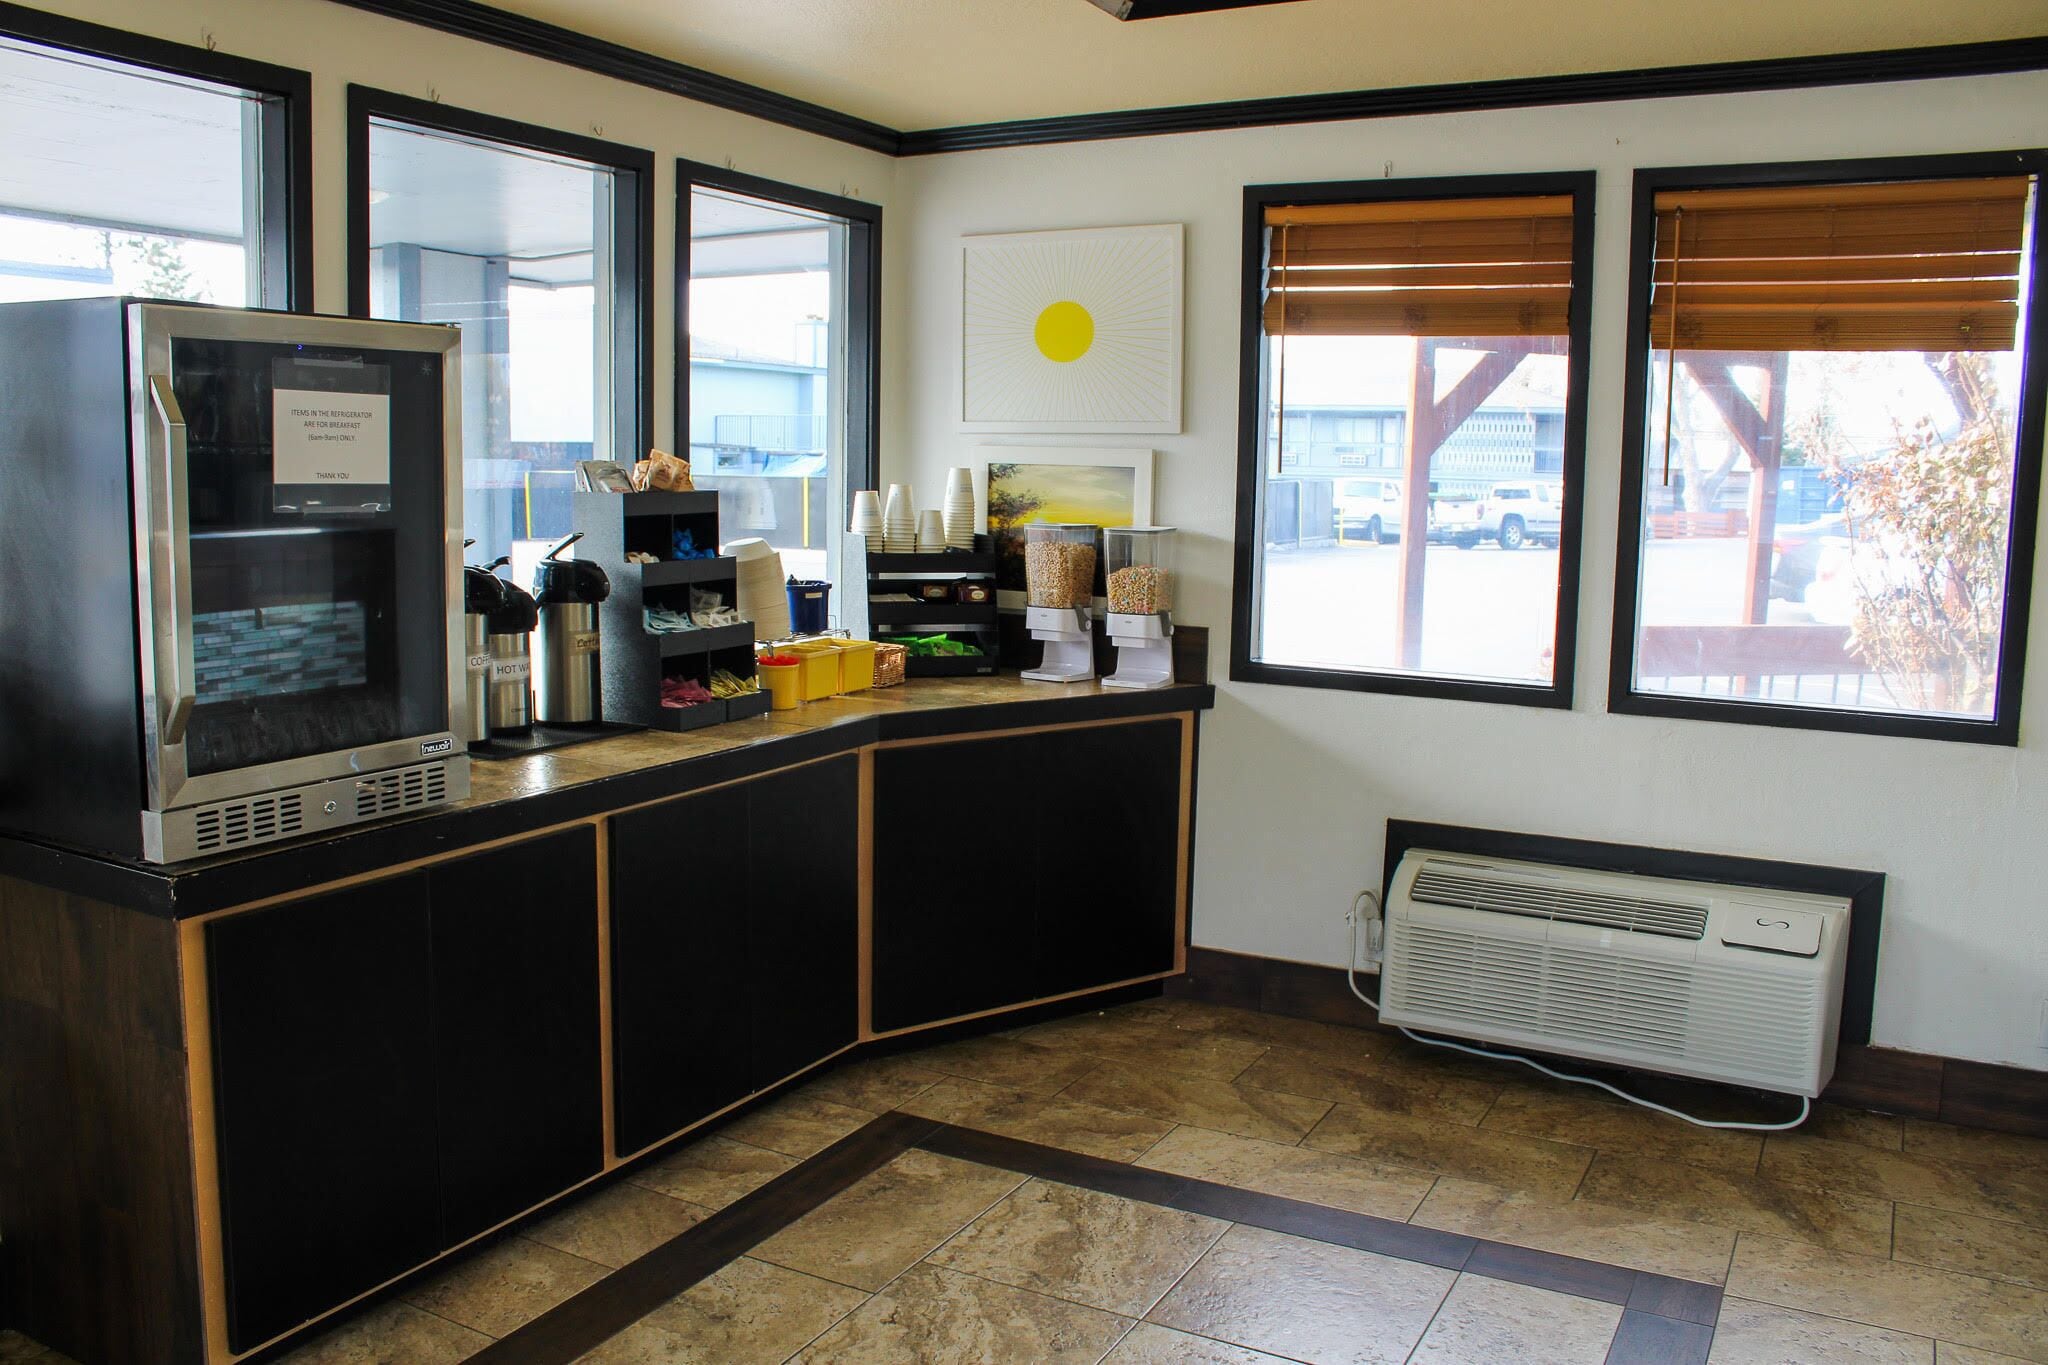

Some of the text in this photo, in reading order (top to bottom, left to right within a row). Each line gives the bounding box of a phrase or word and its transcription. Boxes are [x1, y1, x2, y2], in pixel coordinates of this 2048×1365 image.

[291, 409, 309, 417] ITEMS
[318, 410, 330, 418] THE
[331, 410, 373, 419] REFRIGERATOR
[329, 421, 361, 429] BREAKFAST
[496, 664, 516, 674] HOT
[424, 740, 450, 752] newair
